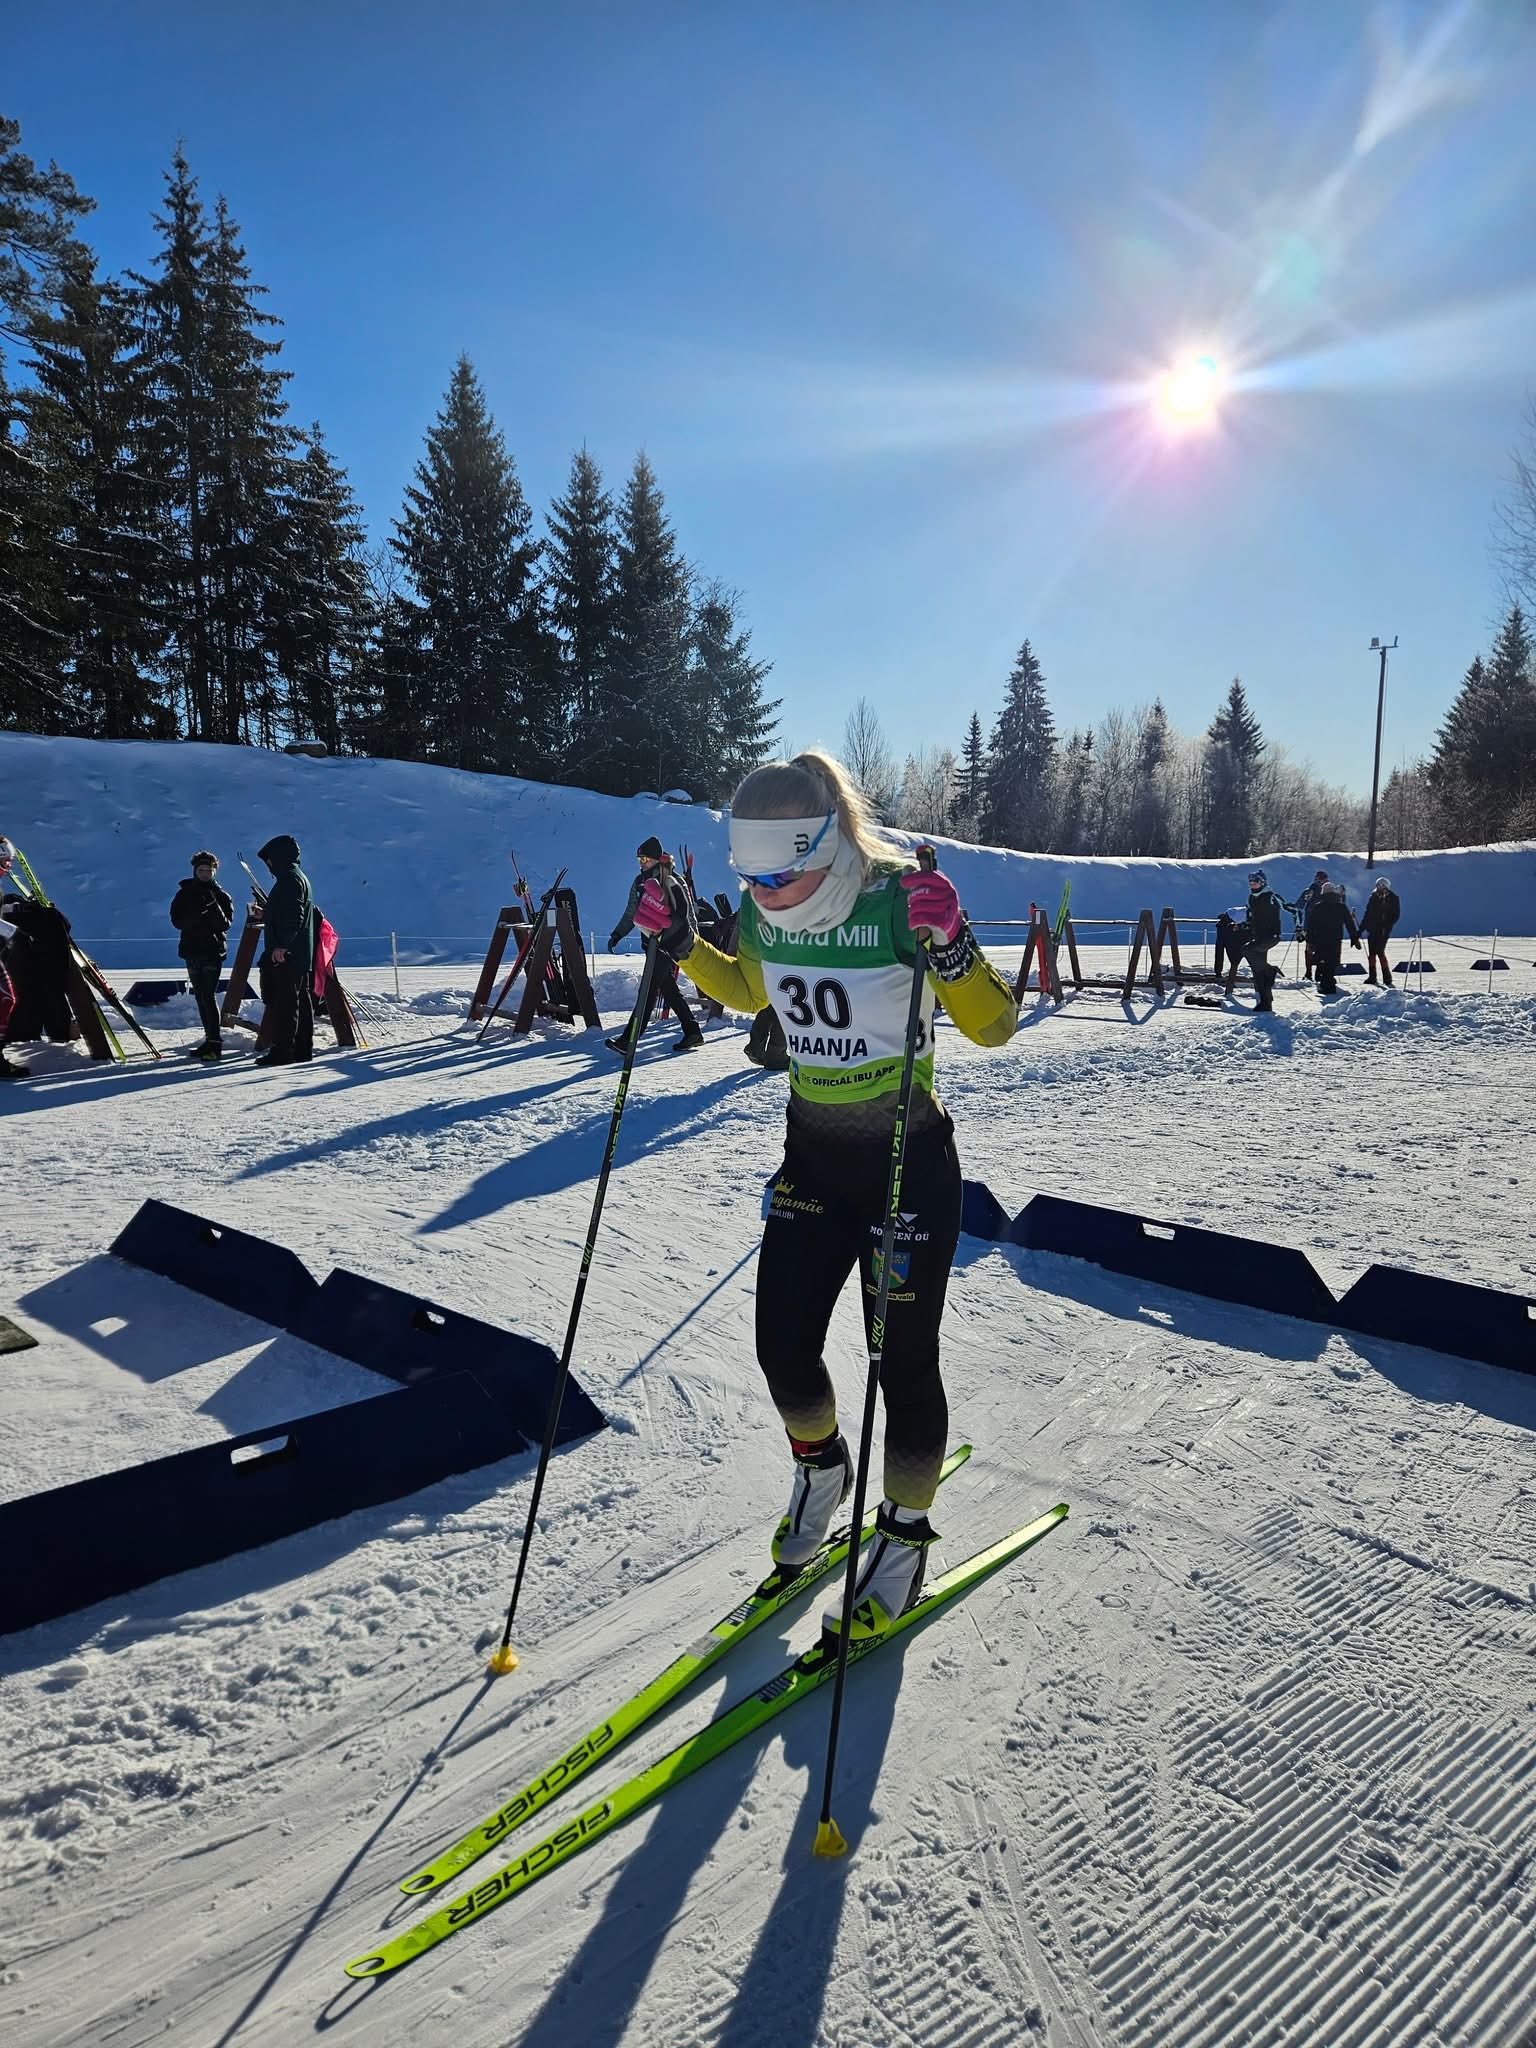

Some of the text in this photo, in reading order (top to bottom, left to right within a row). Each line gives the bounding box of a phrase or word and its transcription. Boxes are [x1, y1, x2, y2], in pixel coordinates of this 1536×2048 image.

[836, 925, 879, 947] Mill
[777, 974, 853, 1030] 30
[789, 1034, 868, 1062] HAANJA
[812, 1075, 852, 1087] OFFICIAL
[854, 1071, 872, 1084] IBU
[874, 1065, 896, 1079] APP
[891, 1104, 905, 1158] LEKI
[890, 1164, 903, 1217] LEKI
[878, 1528, 923, 1548] FISCHER
[776, 1557, 830, 1607] FISCHER
[481, 1724, 614, 1841] FISCHER
[446, 1802, 614, 1925] FISCHER
